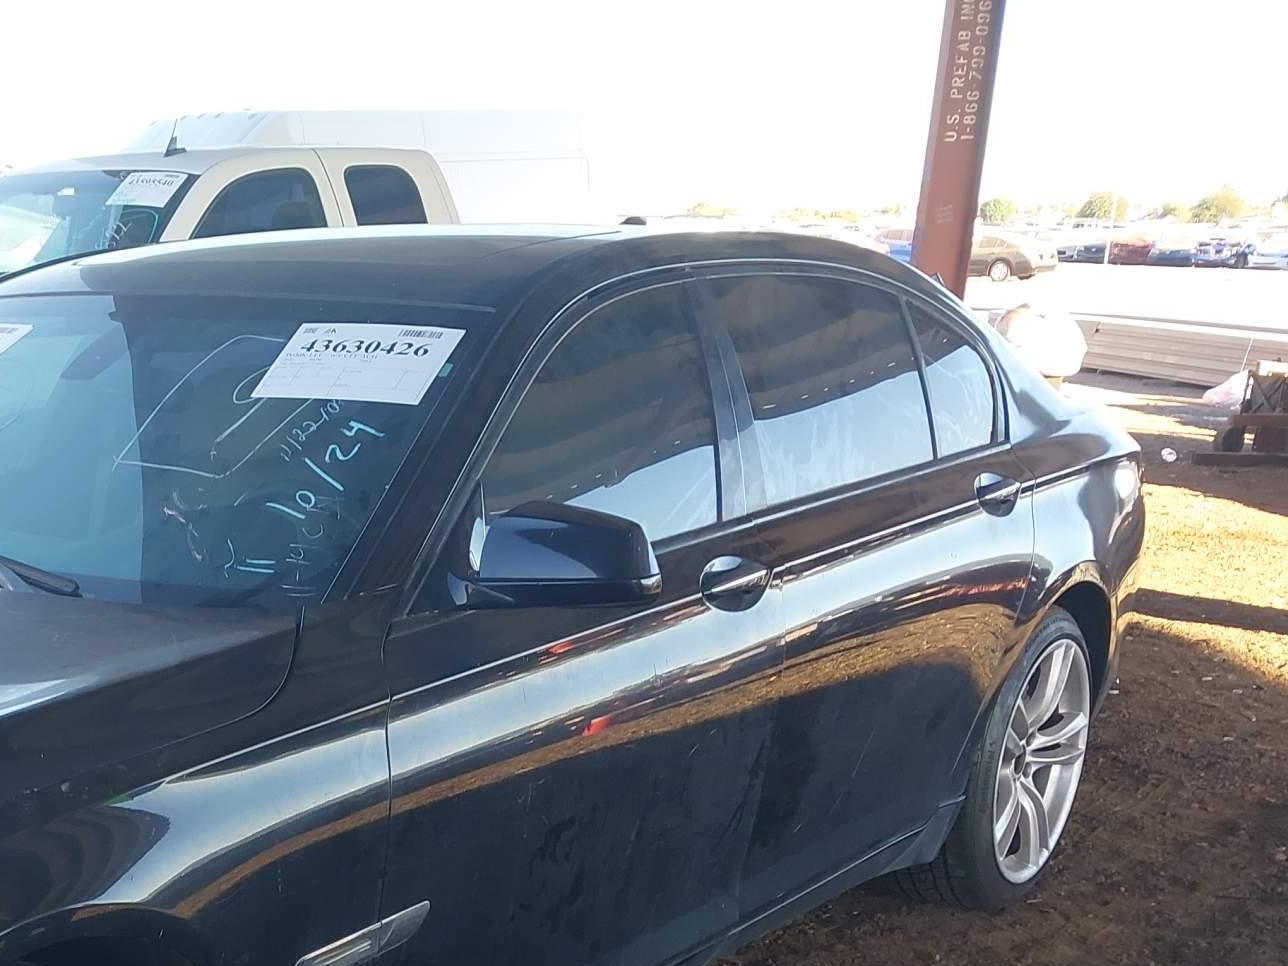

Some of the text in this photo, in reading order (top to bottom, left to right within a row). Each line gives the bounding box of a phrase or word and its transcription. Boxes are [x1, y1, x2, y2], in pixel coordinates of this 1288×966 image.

[950, 30, 971, 99] PREFAB
[944, 110, 961, 142] U.S.
[300, 338, 432, 358] 43630426
